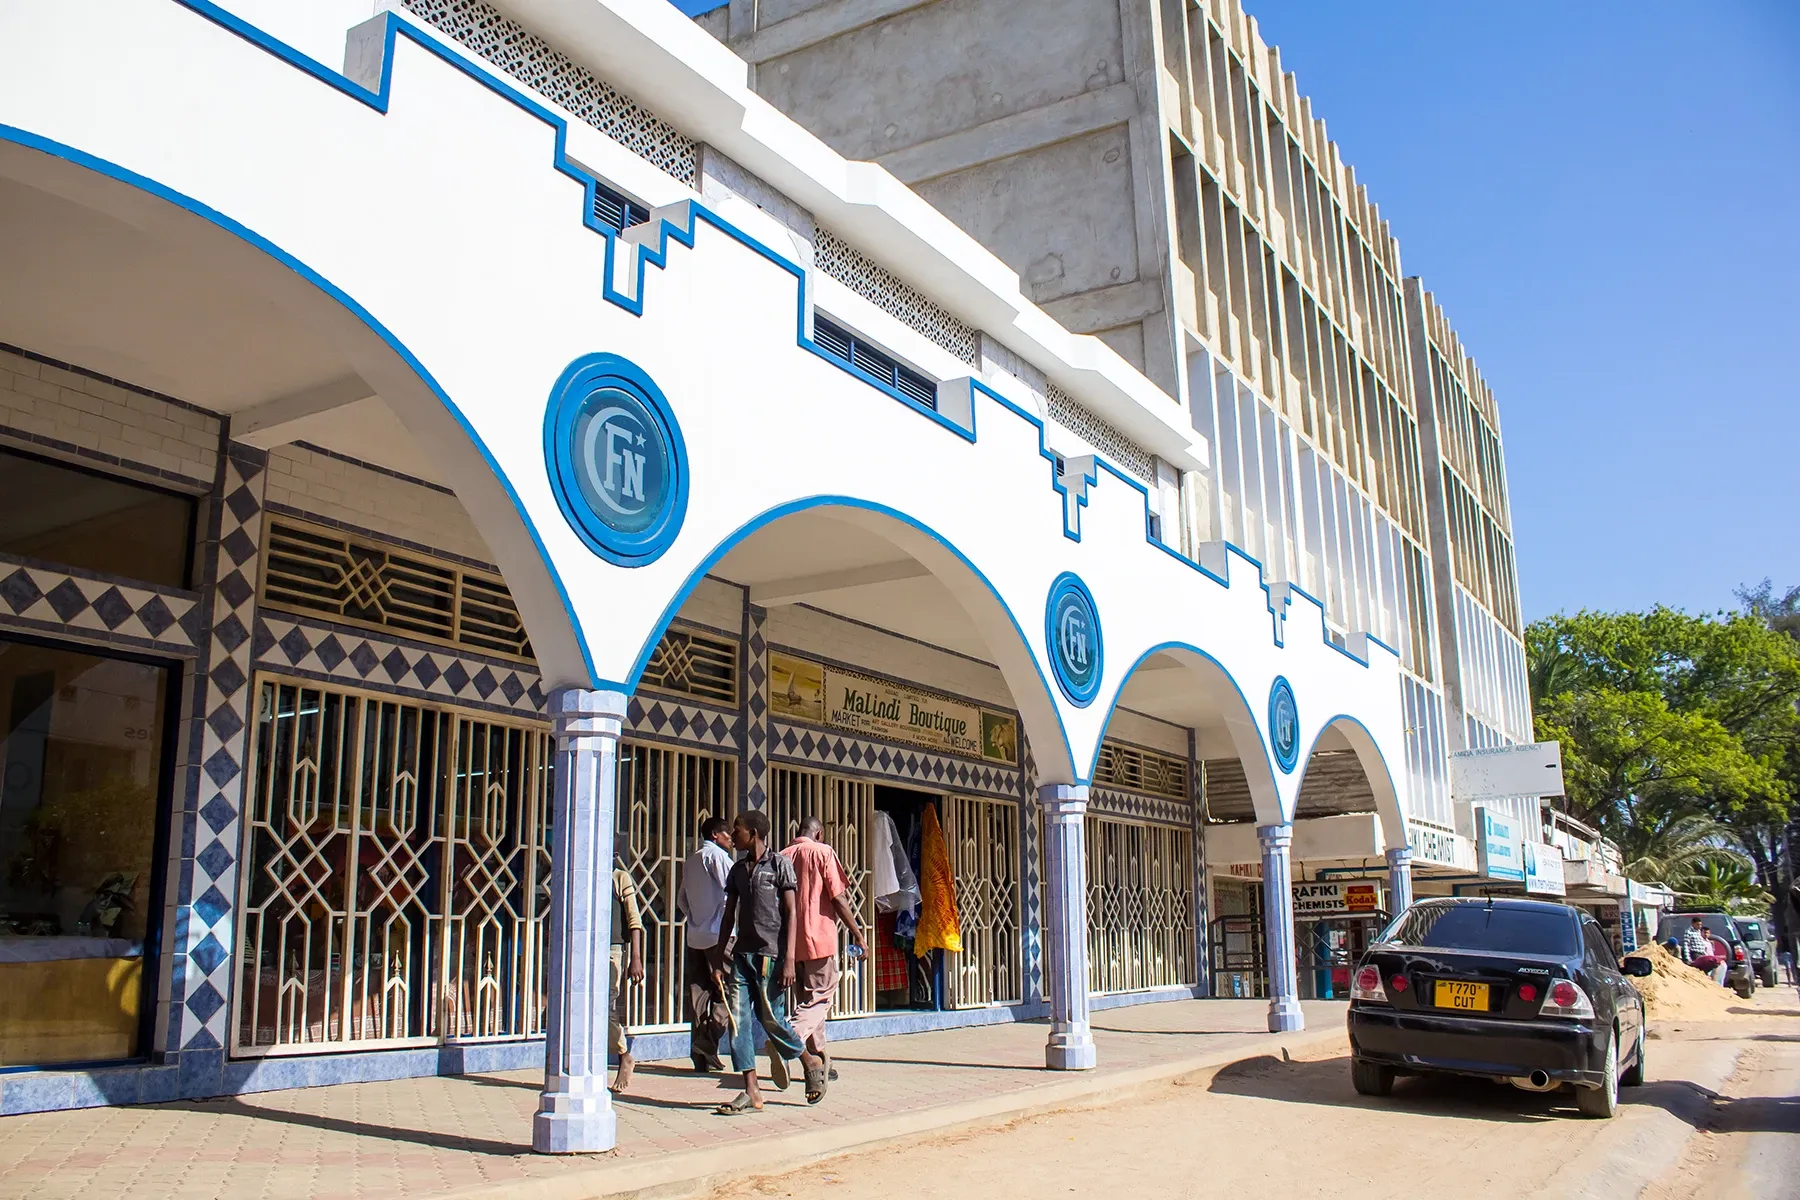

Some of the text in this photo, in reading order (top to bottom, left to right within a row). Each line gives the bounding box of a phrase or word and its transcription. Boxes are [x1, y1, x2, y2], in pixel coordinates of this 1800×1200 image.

[831, 709, 860, 727] MARKET
[843, 687, 967, 737] Malindi Boutique
[950, 736, 977, 751] WELCOME
[1475, 747, 1512, 756] INSURANCE
[1515, 744, 1542, 752] AGENCY
[1423, 831, 1454, 864] CHEMIST
[1292, 885, 1338, 900] RAFIKI
[1346, 894, 1377, 905] Kodak
[1293, 900, 1345, 910] CHEMISTS
[1454, 995, 1476, 1008] CUT
